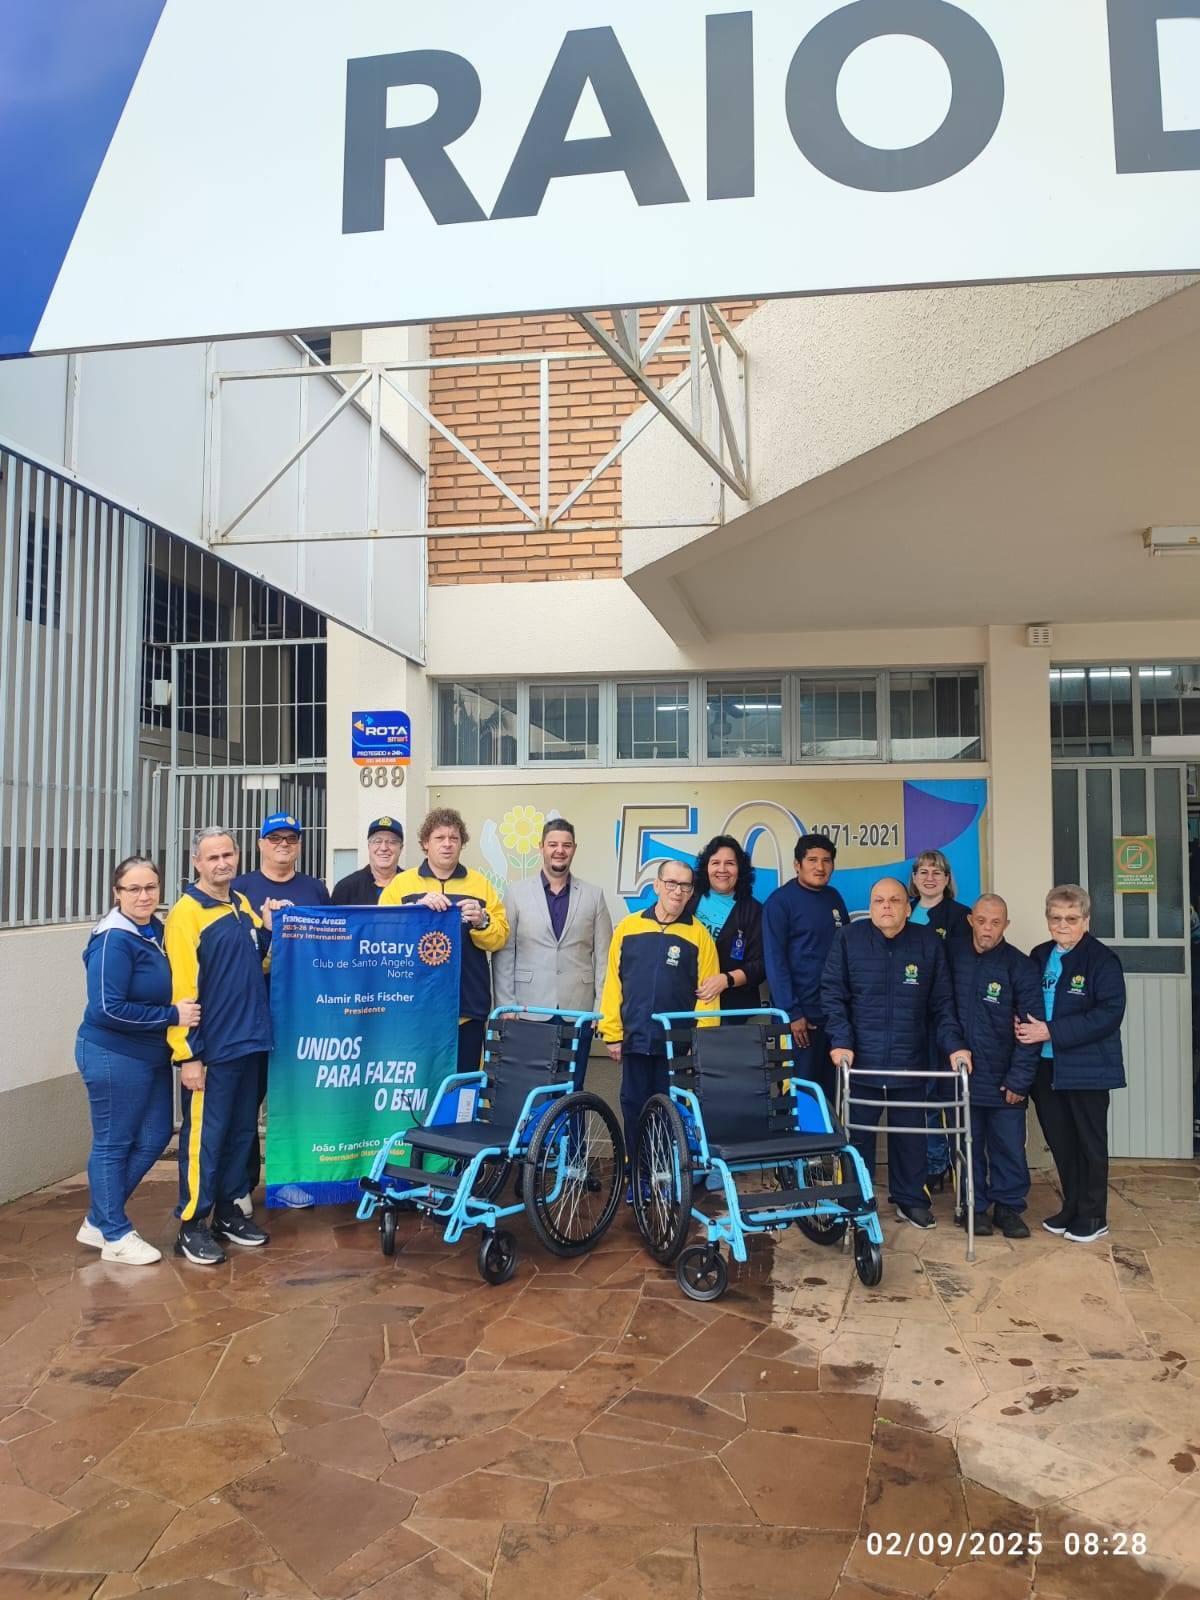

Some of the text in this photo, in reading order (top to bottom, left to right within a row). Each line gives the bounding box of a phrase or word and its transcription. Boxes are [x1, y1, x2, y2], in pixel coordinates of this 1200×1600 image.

[342, 0, 1005, 235] RAIO
[365, 726, 407, 736] ROTA
[360, 766, 405, 788] 689
[282, 914, 346, 925] Francesco Arezzo
[360, 940, 414, 957] Rotary
[312, 956, 415, 969] Club de Santo Ângelo
[387, 969, 415, 979] Norte
[315, 992, 415, 1004] Alamir Reis Fischer
[343, 1006, 386, 1015] Presidente
[296, 1036, 363, 1061] UNIDOS
[315, 1060, 417, 1088] PARA FAZER
[374, 1087, 388, 1111] O
[390, 1087, 429, 1112] BEM
[312, 1143, 336, 1153] João
[338, 1138, 381, 1152] Francisco
